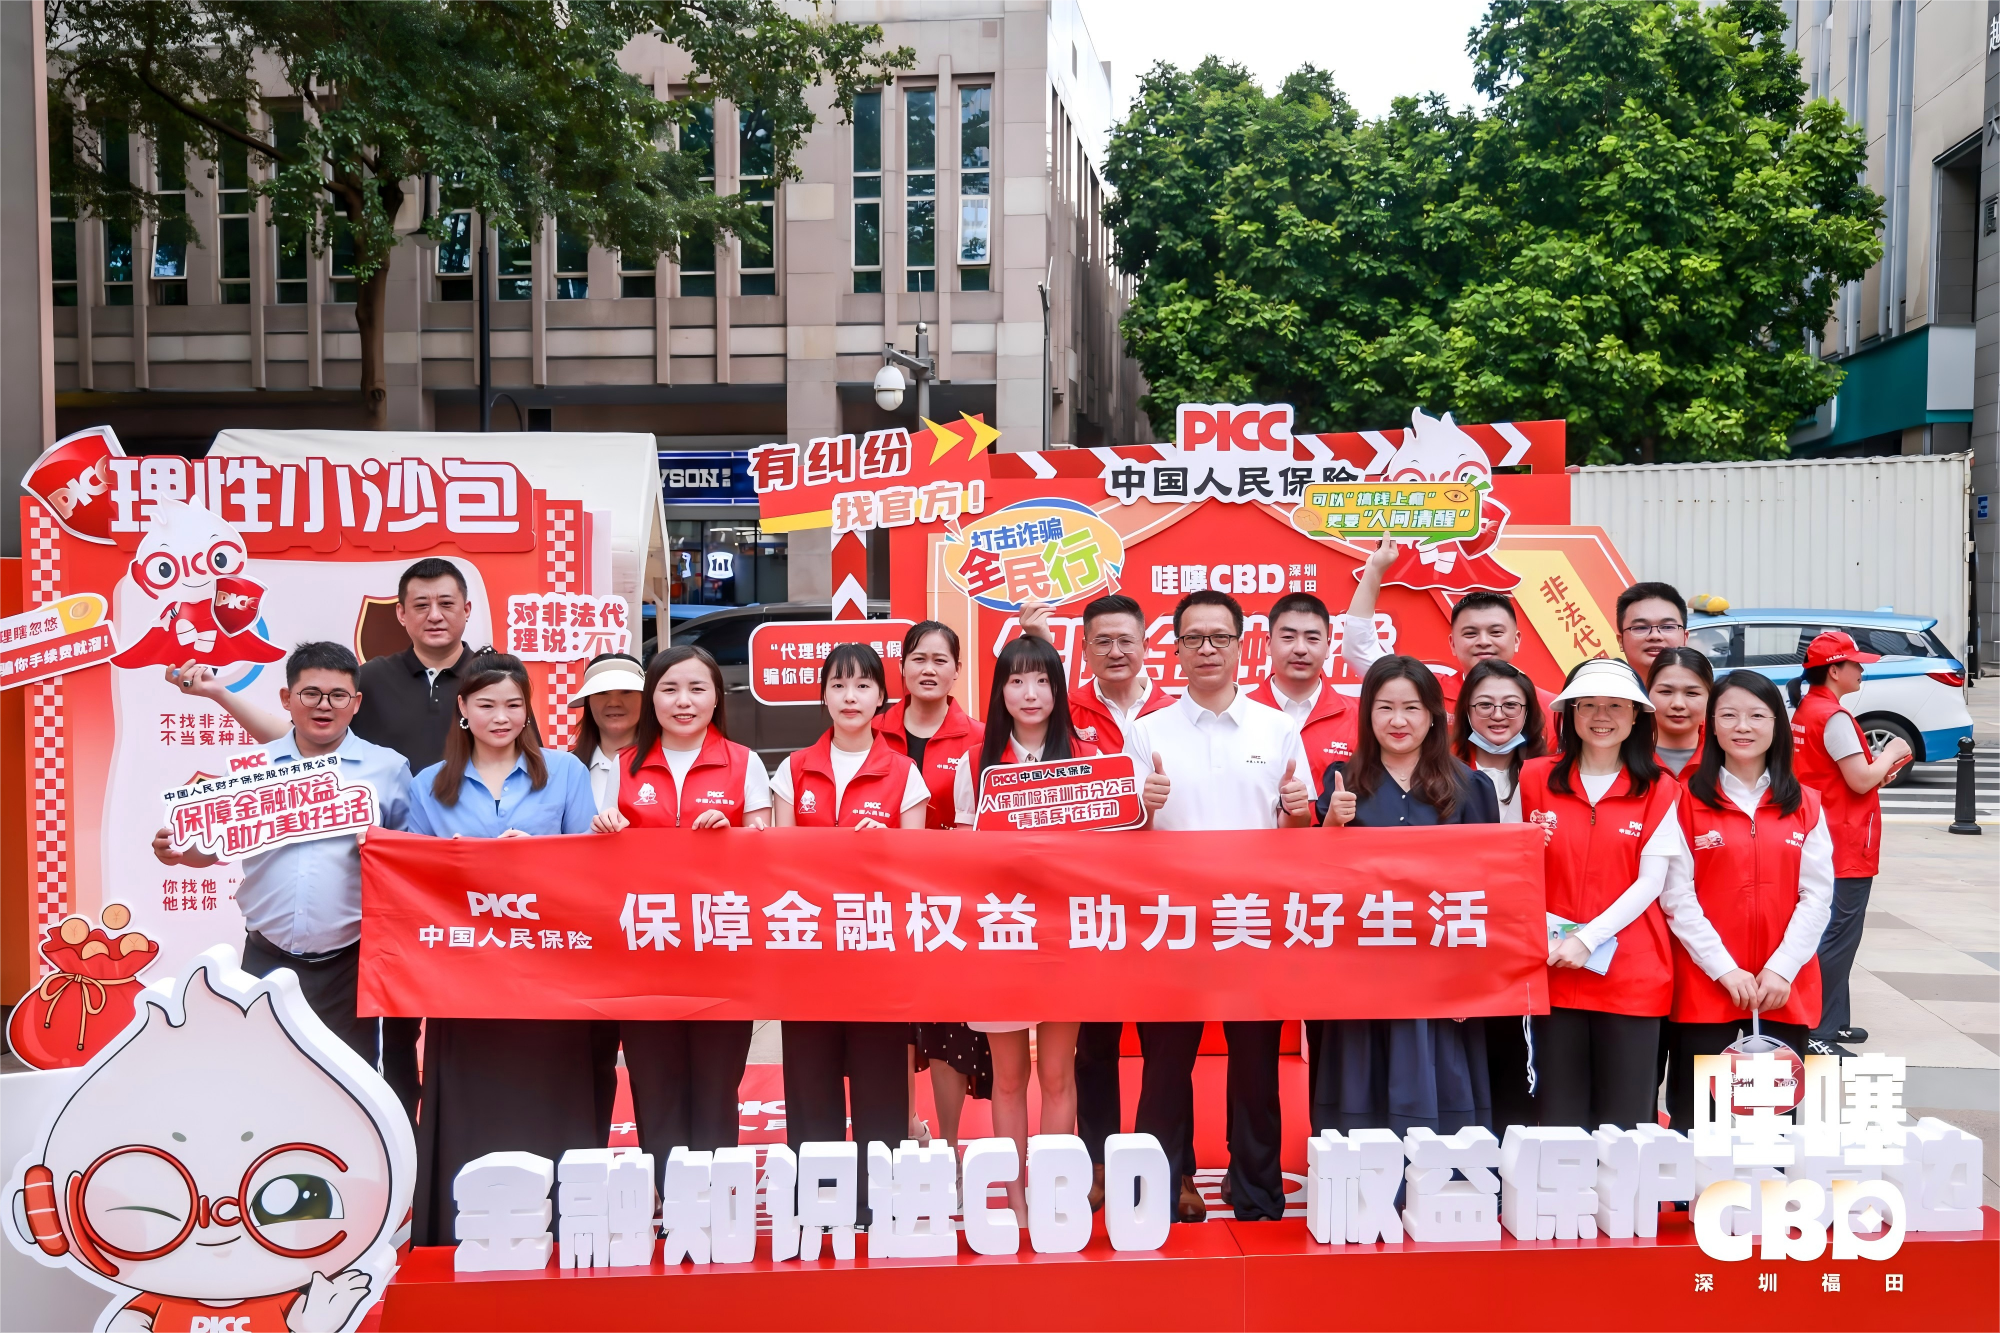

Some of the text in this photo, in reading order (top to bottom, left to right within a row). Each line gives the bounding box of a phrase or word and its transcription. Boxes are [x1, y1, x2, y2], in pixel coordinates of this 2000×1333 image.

[1183, 410, 1288, 452] PICC
[751, 431, 910, 490] 有纠纷
[109, 456, 521, 533] 理性小沙包
[836, 484, 981, 531] 找官方！
[971, 517, 1064, 552] 打击诈骗
[958, 528, 1101, 602] 全民行
[1288, 564, 1317, 577] 深圳
[1288, 579, 1317, 593] 福田
[513, 602, 625, 627] 对非法代
[1540, 575, 1610, 659] 非法代
[160, 713, 242, 729] 不找非法
[164, 755, 338, 802] 中国人民财产保险股份有限公司
[230, 752, 268, 773] PICC
[992, 772, 1018, 787] PICC
[1019, 765, 1093, 783] 中国人民保险
[174, 775, 341, 844] 保障金融权益
[981, 778, 1137, 812] 人保财险深圳市分公司
[226, 789, 372, 851] 助力美好生活
[1008, 800, 1119, 829] “青骑兵”在行动
[466, 890, 541, 921] PICC
[619, 889, 1488, 953] 保障金融权益 助力美好生活
[418, 924, 594, 951] 中国人民保险
[453, 1132, 1171, 1273] 金融知识进CBD
[190, 1315, 253, 1333] PICC
